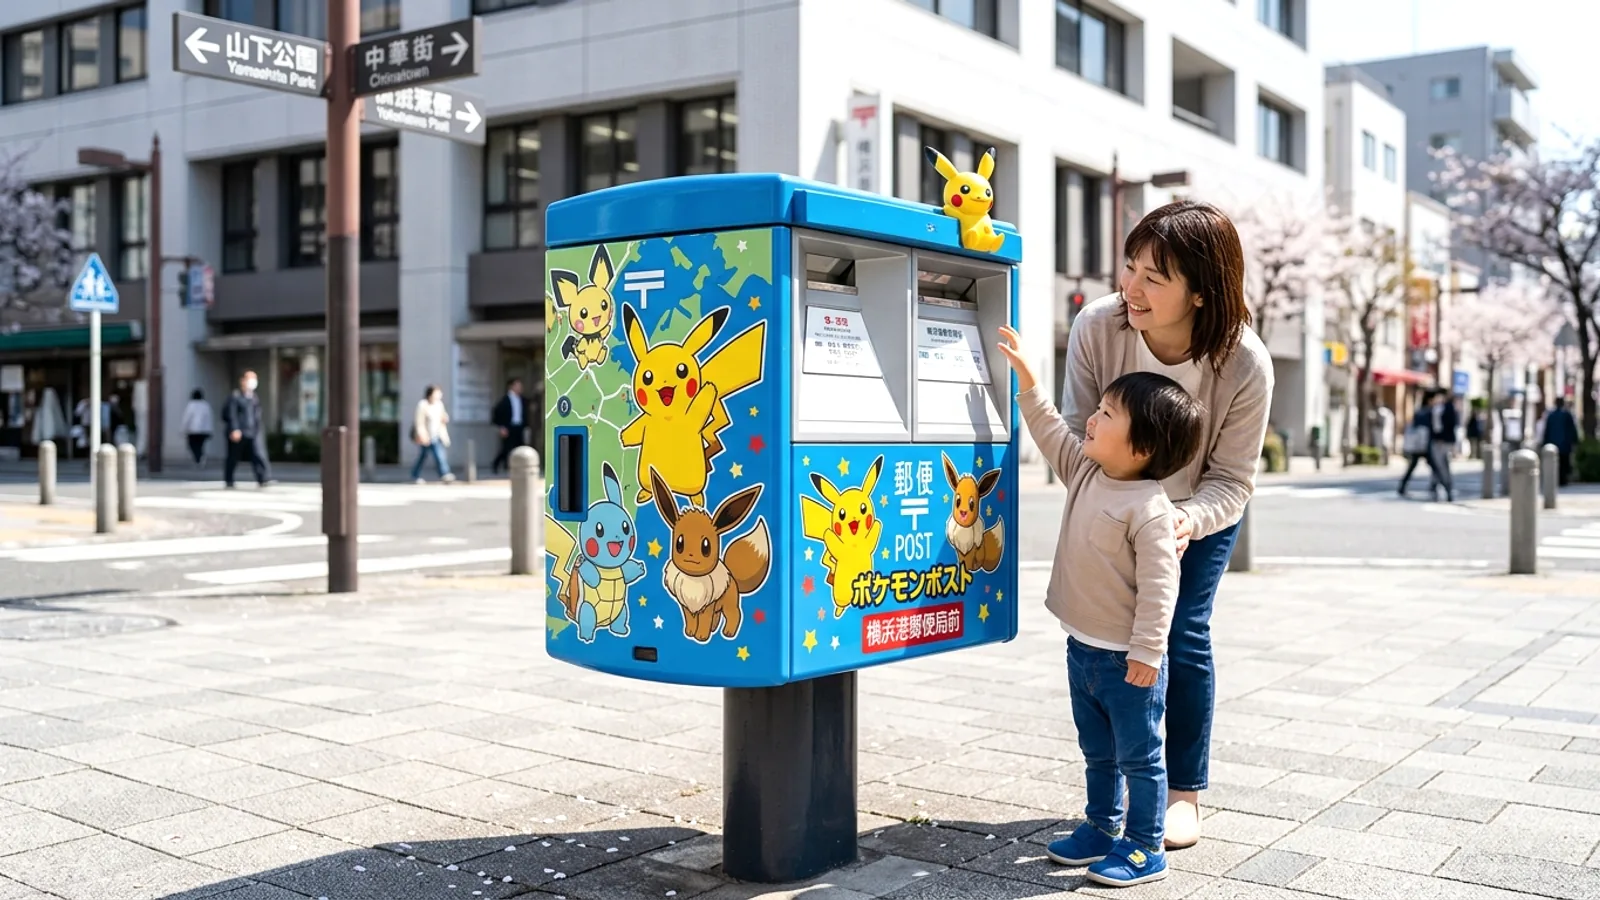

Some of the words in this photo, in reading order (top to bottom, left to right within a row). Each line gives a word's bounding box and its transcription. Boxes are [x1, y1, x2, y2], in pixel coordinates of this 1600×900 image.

[226, 31, 318, 74] 山下公園
[365, 34, 434, 71] 中華街
[289, 72, 317, 90] Park
[894, 460, 934, 496] 郵便
[895, 532, 933, 562] POST
